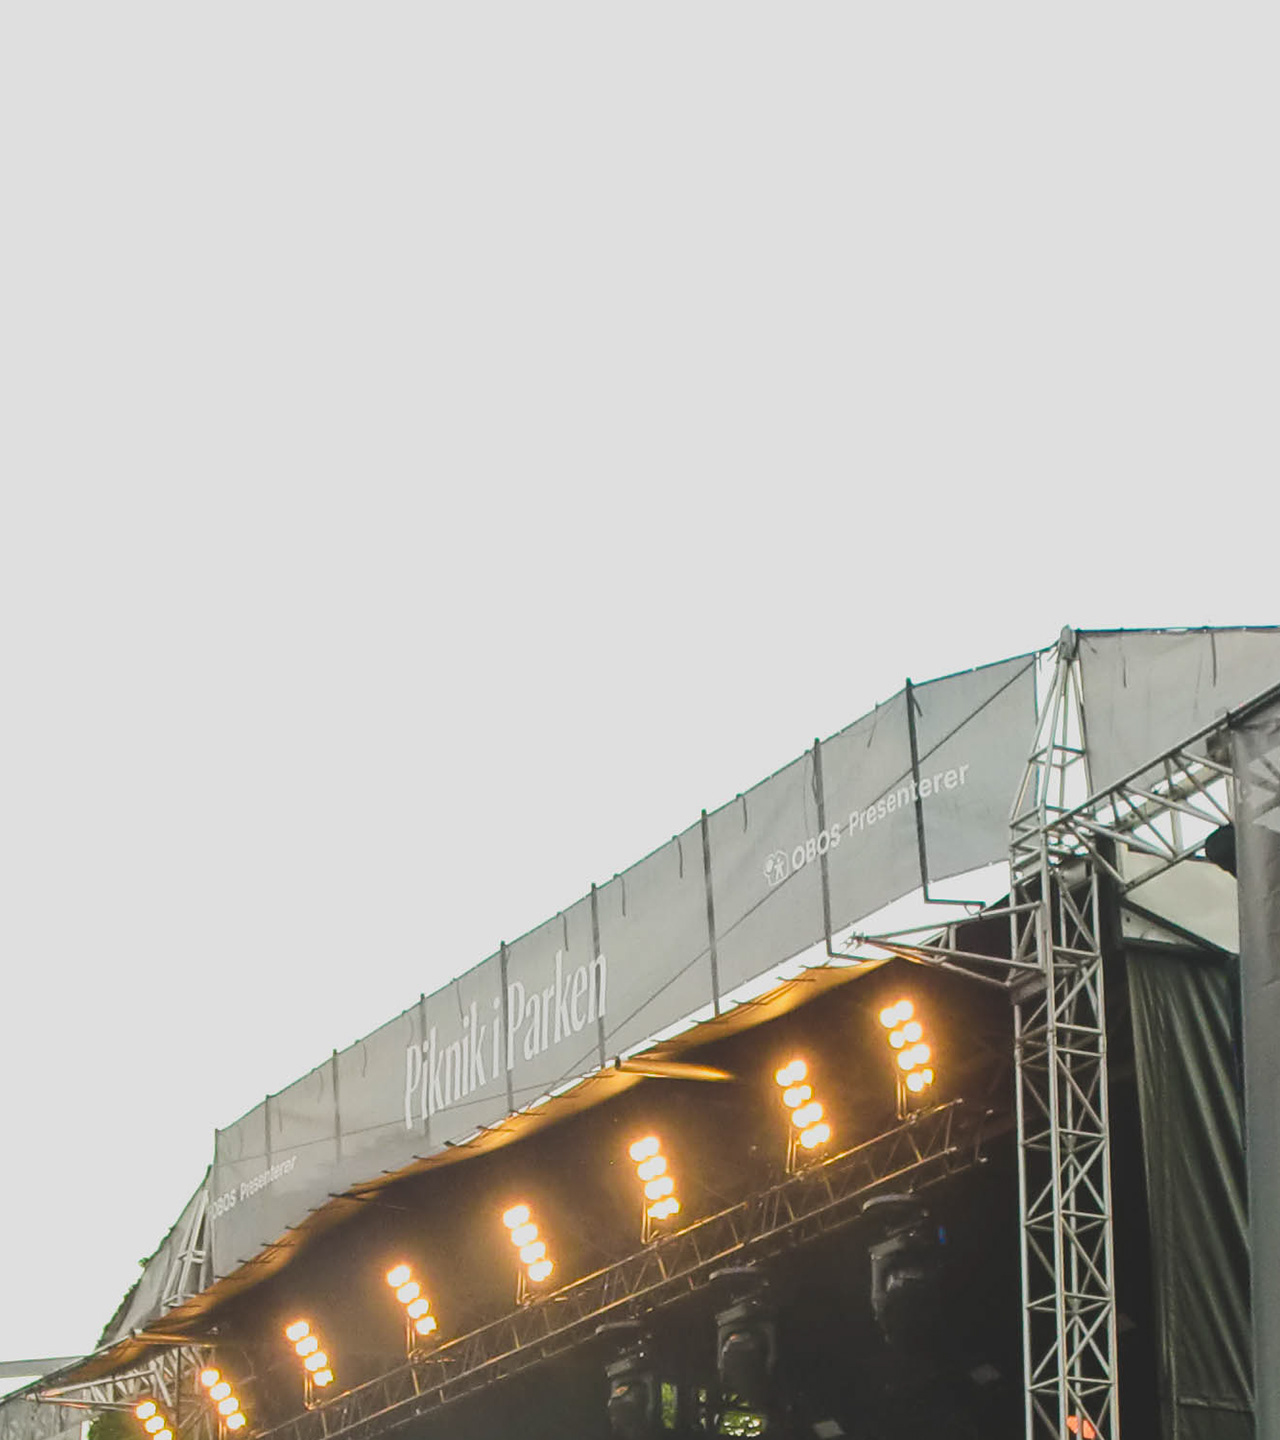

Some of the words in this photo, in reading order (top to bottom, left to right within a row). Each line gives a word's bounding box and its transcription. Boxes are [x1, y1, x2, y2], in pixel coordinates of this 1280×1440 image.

[792, 824, 842, 870] OBOS
[849, 764, 969, 835] Presenterer
[405, 1001, 487, 1130] Piknik
[492, 996, 501, 1079] i
[507, 950, 607, 1071] Parken
